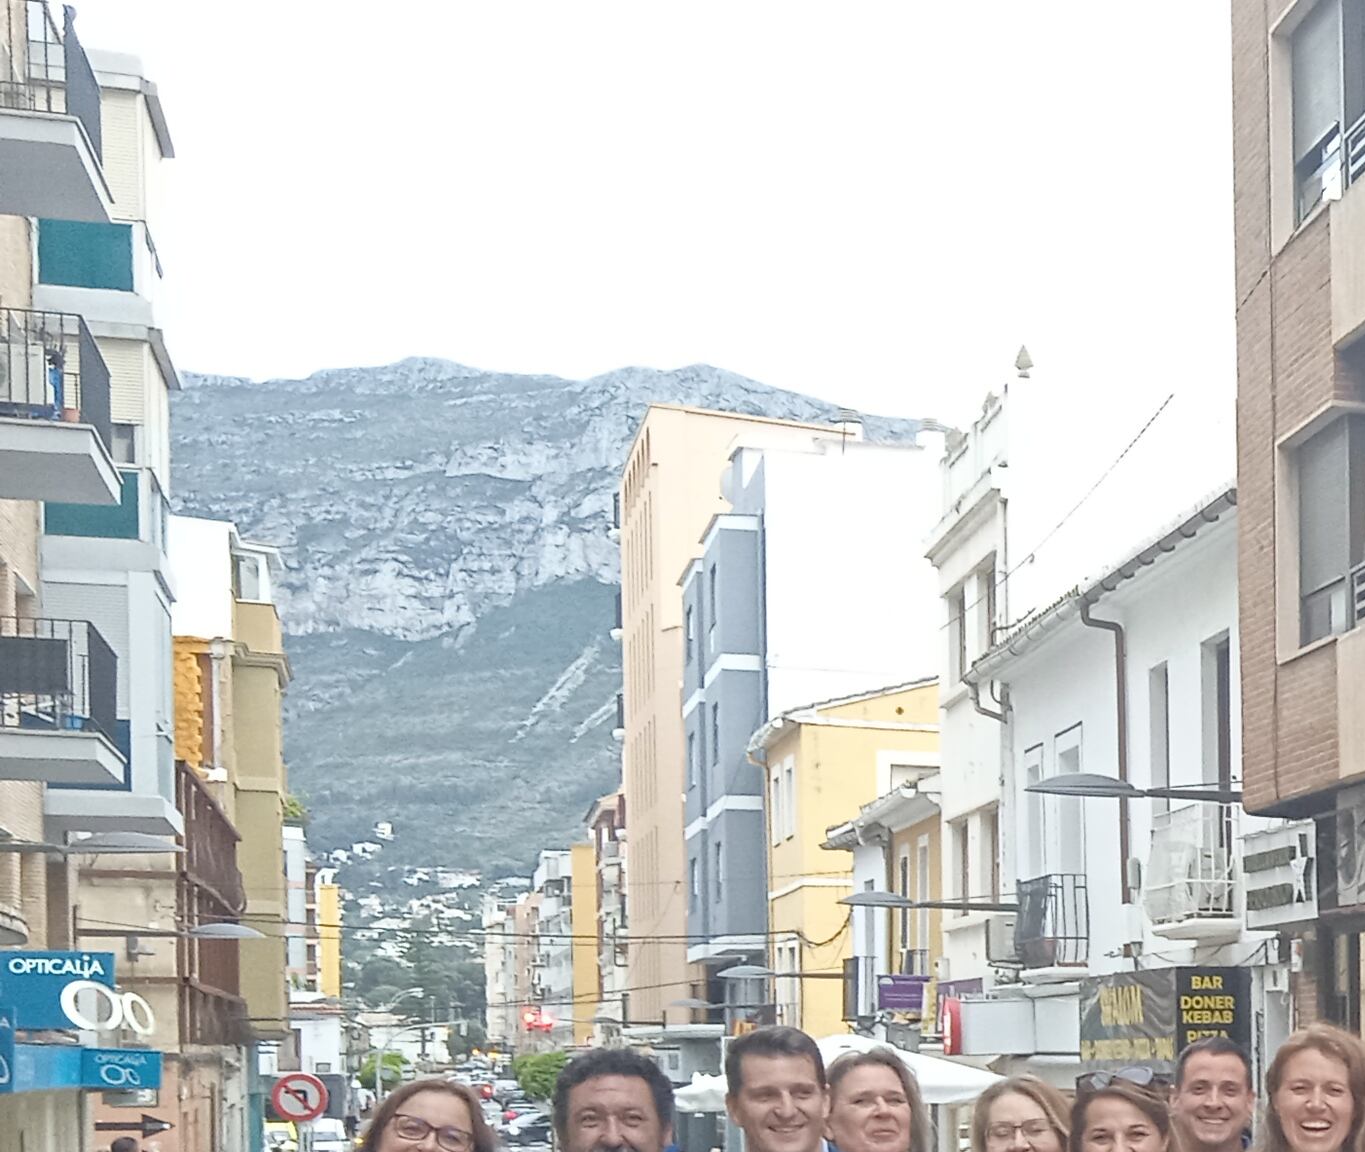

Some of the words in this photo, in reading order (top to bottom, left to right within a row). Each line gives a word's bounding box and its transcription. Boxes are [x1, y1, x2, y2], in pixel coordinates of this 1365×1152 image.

[1191, 975, 1223, 990] BAR
[1180, 995, 1235, 1010] DONER
[1182, 1010, 1233, 1024] KEBAB
